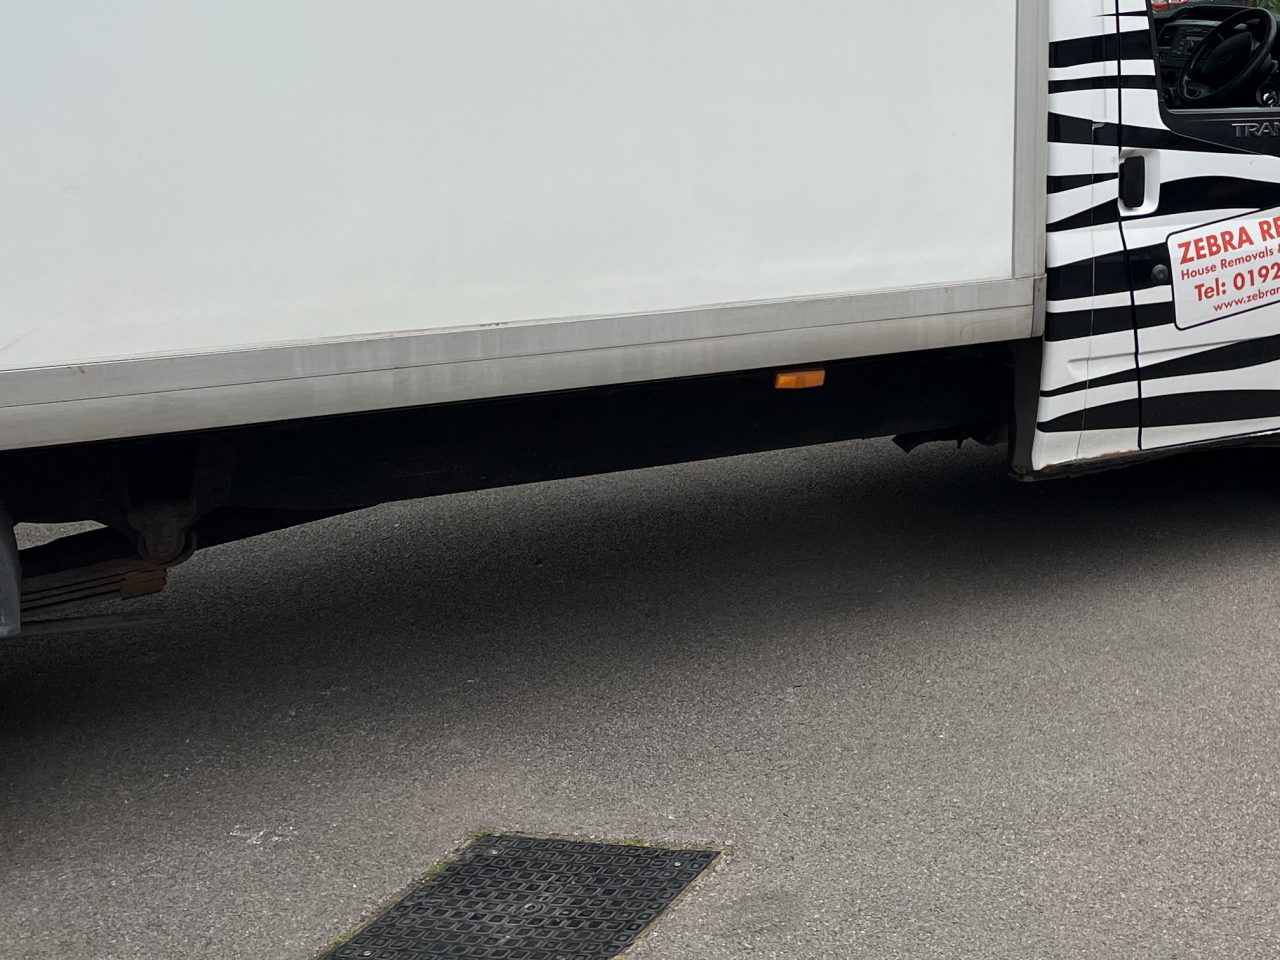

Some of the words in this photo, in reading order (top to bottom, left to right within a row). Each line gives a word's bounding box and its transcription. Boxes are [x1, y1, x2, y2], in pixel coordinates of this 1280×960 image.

[1178, 226, 1254, 264] ZEBRA
[1181, 264, 1216, 281] House
[1221, 246, 1273, 269] Removals
[1194, 277, 1227, 302] Tel:
